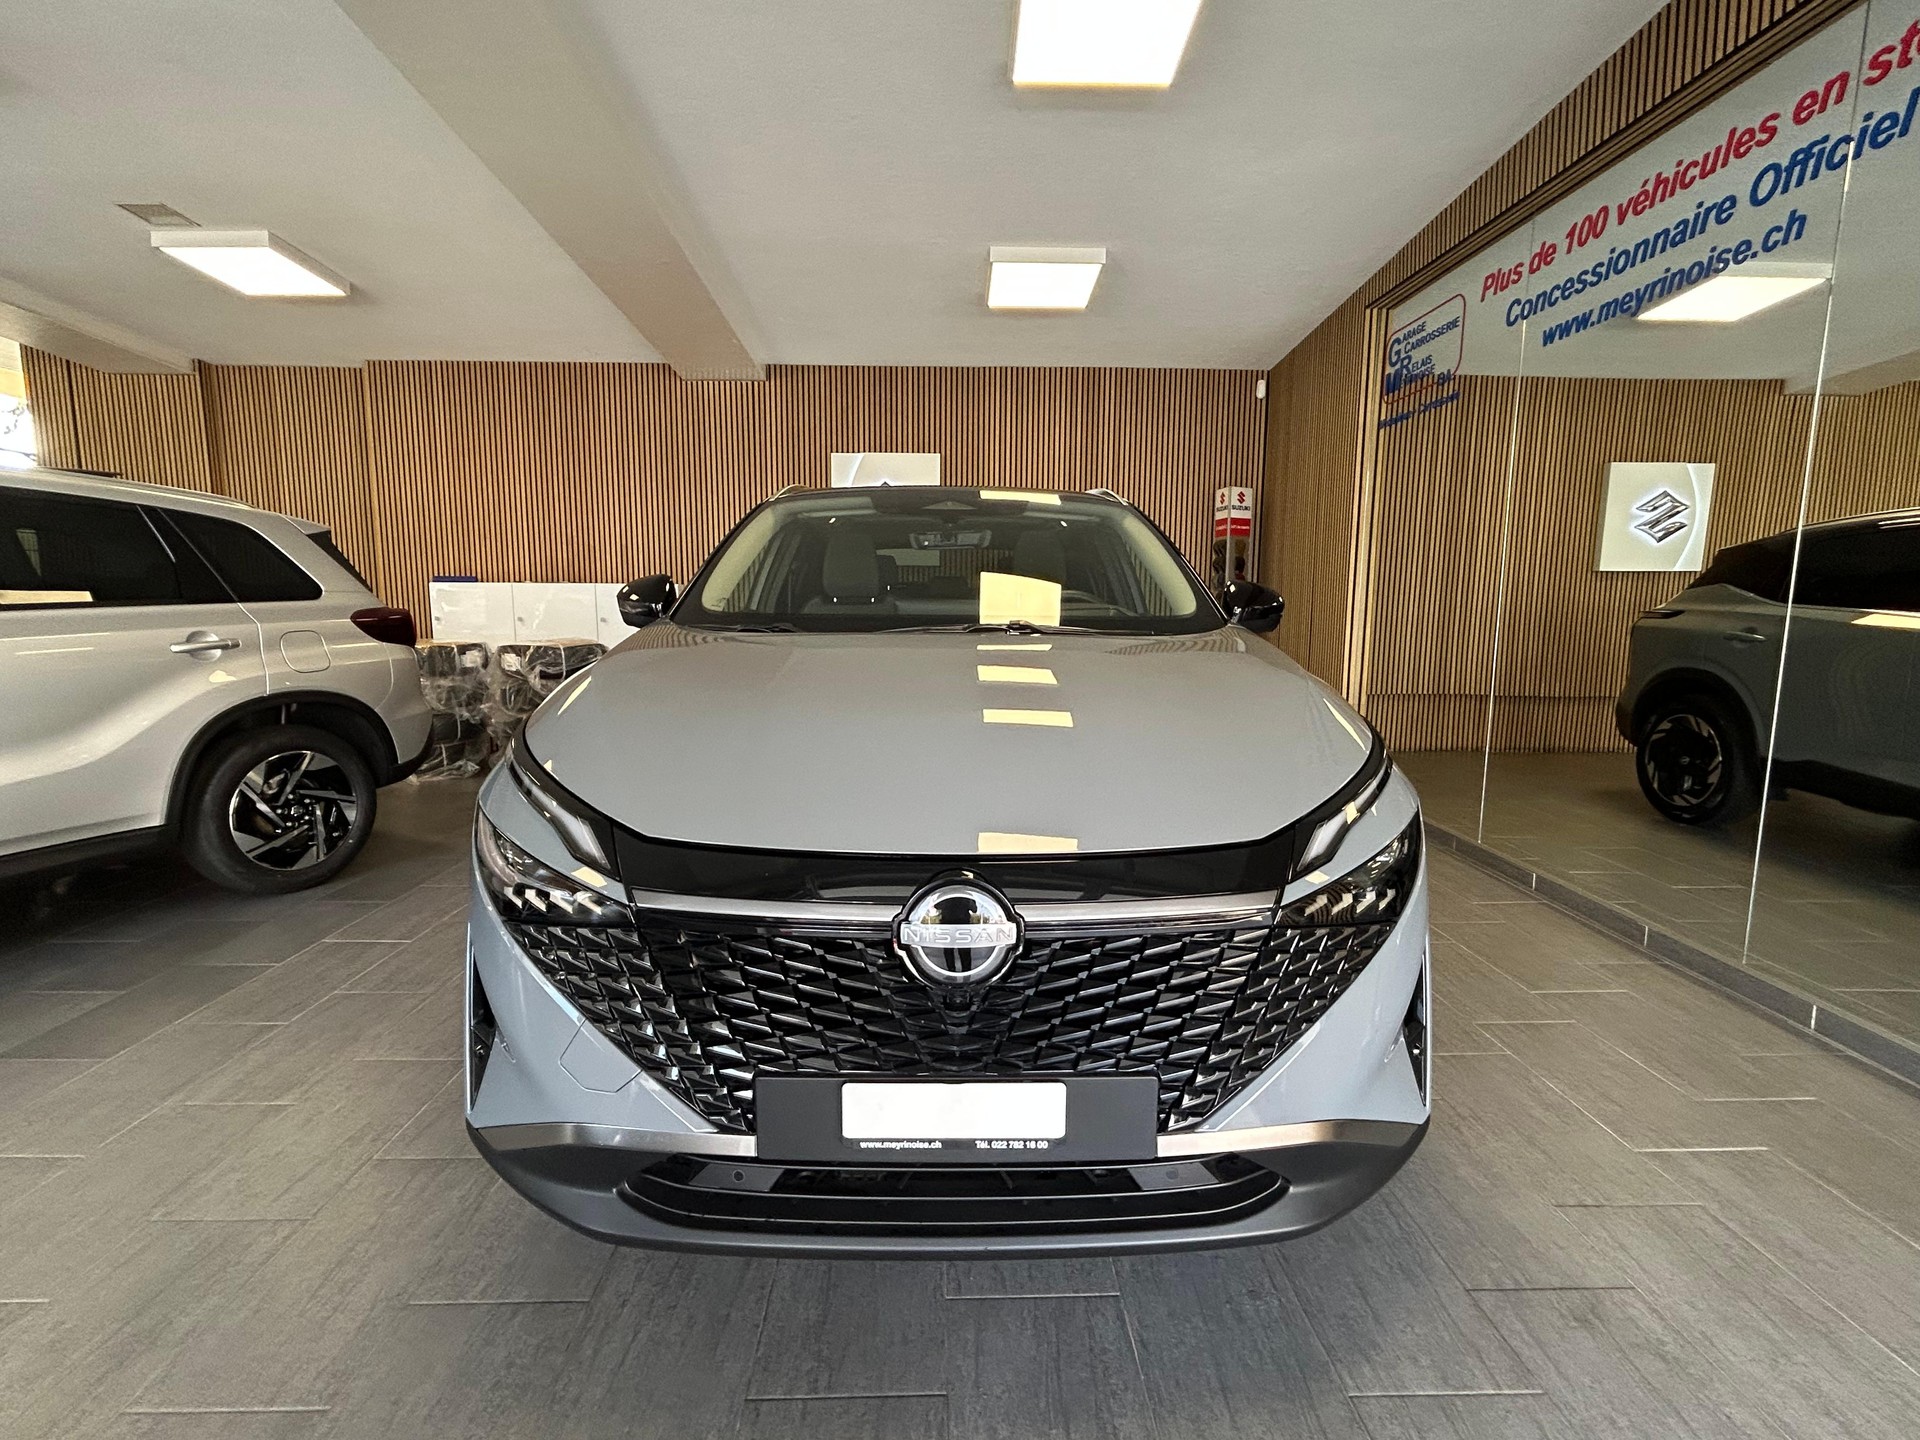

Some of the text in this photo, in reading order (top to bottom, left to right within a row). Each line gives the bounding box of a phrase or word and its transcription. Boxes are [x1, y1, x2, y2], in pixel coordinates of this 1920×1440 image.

[1481, 19, 1920, 302] Plus de 100 véhicules en st
[1506, 86, 1920, 327] Concessionnaire Officiel
[1542, 209, 1807, 347] www.meyrinoise.ch
[1404, 316, 1460, 354] CARROSSERIE
[1400, 354, 1433, 376] RELAIS
[904, 927, 1013, 943] NISSAN
[860, 1140, 942, 1150] www.meyrinoise.ch
[991, 1140, 1007, 1149] 022
[1037, 1140, 1048, 1149] 00
